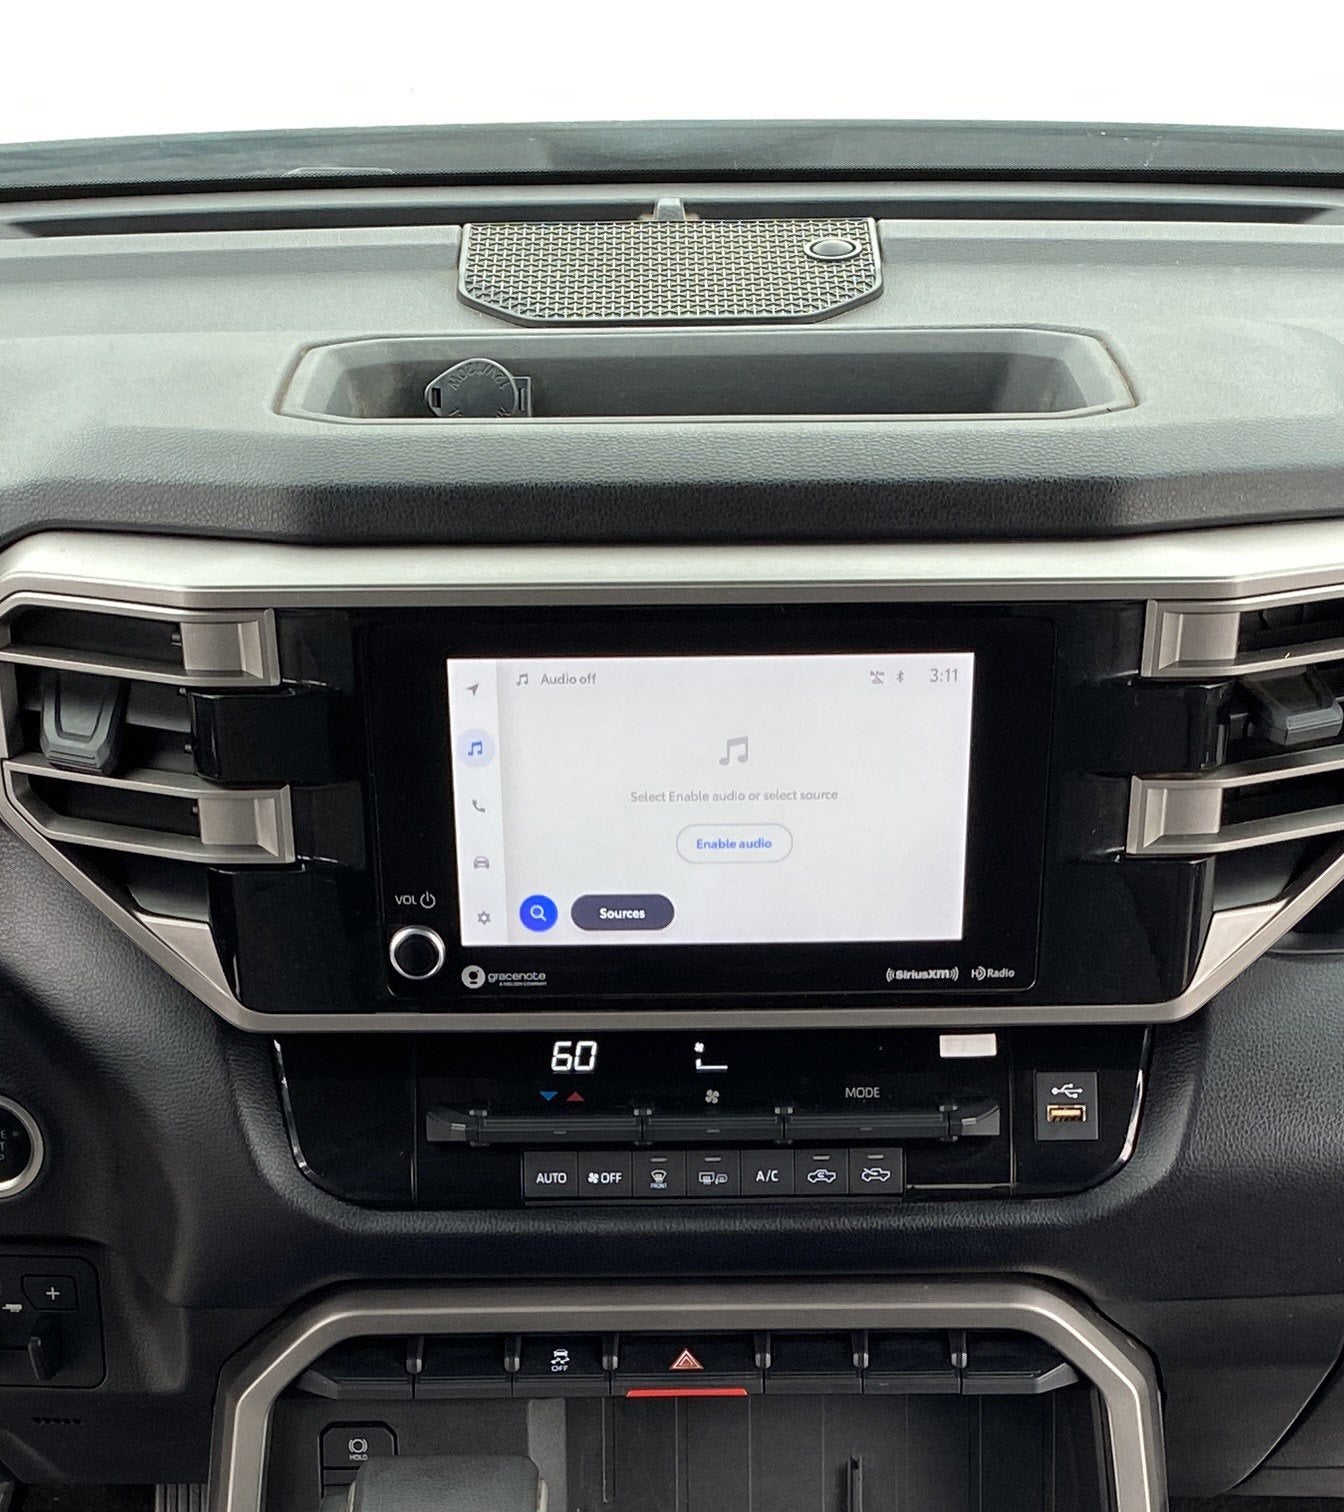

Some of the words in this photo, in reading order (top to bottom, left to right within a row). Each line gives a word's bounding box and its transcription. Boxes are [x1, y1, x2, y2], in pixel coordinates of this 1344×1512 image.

[541, 673, 577, 685] Audio
[579, 672, 597, 685] off
[930, 668, 958, 683] 3:11
[630, 791, 666, 803] Select
[669, 790, 709, 802] Enable
[712, 789, 746, 801] audio
[748, 792, 761, 801] or
[763, 789, 797, 801] select
[799, 791, 839, 801] source
[696, 838, 736, 849] Enable
[738, 837, 772, 849] audio
[394, 894, 418, 906] VOL
[599, 907, 646, 920] Sources
[487, 971, 547, 984] gracenote
[987, 968, 1015, 978] Radio
[551, 1040, 598, 1072] 60
[845, 1086, 881, 1099] MODE
[536, 1171, 567, 1184] AUTO
[600, 1171, 622, 1184] OFF
[756, 1169, 779, 1183] A/C
